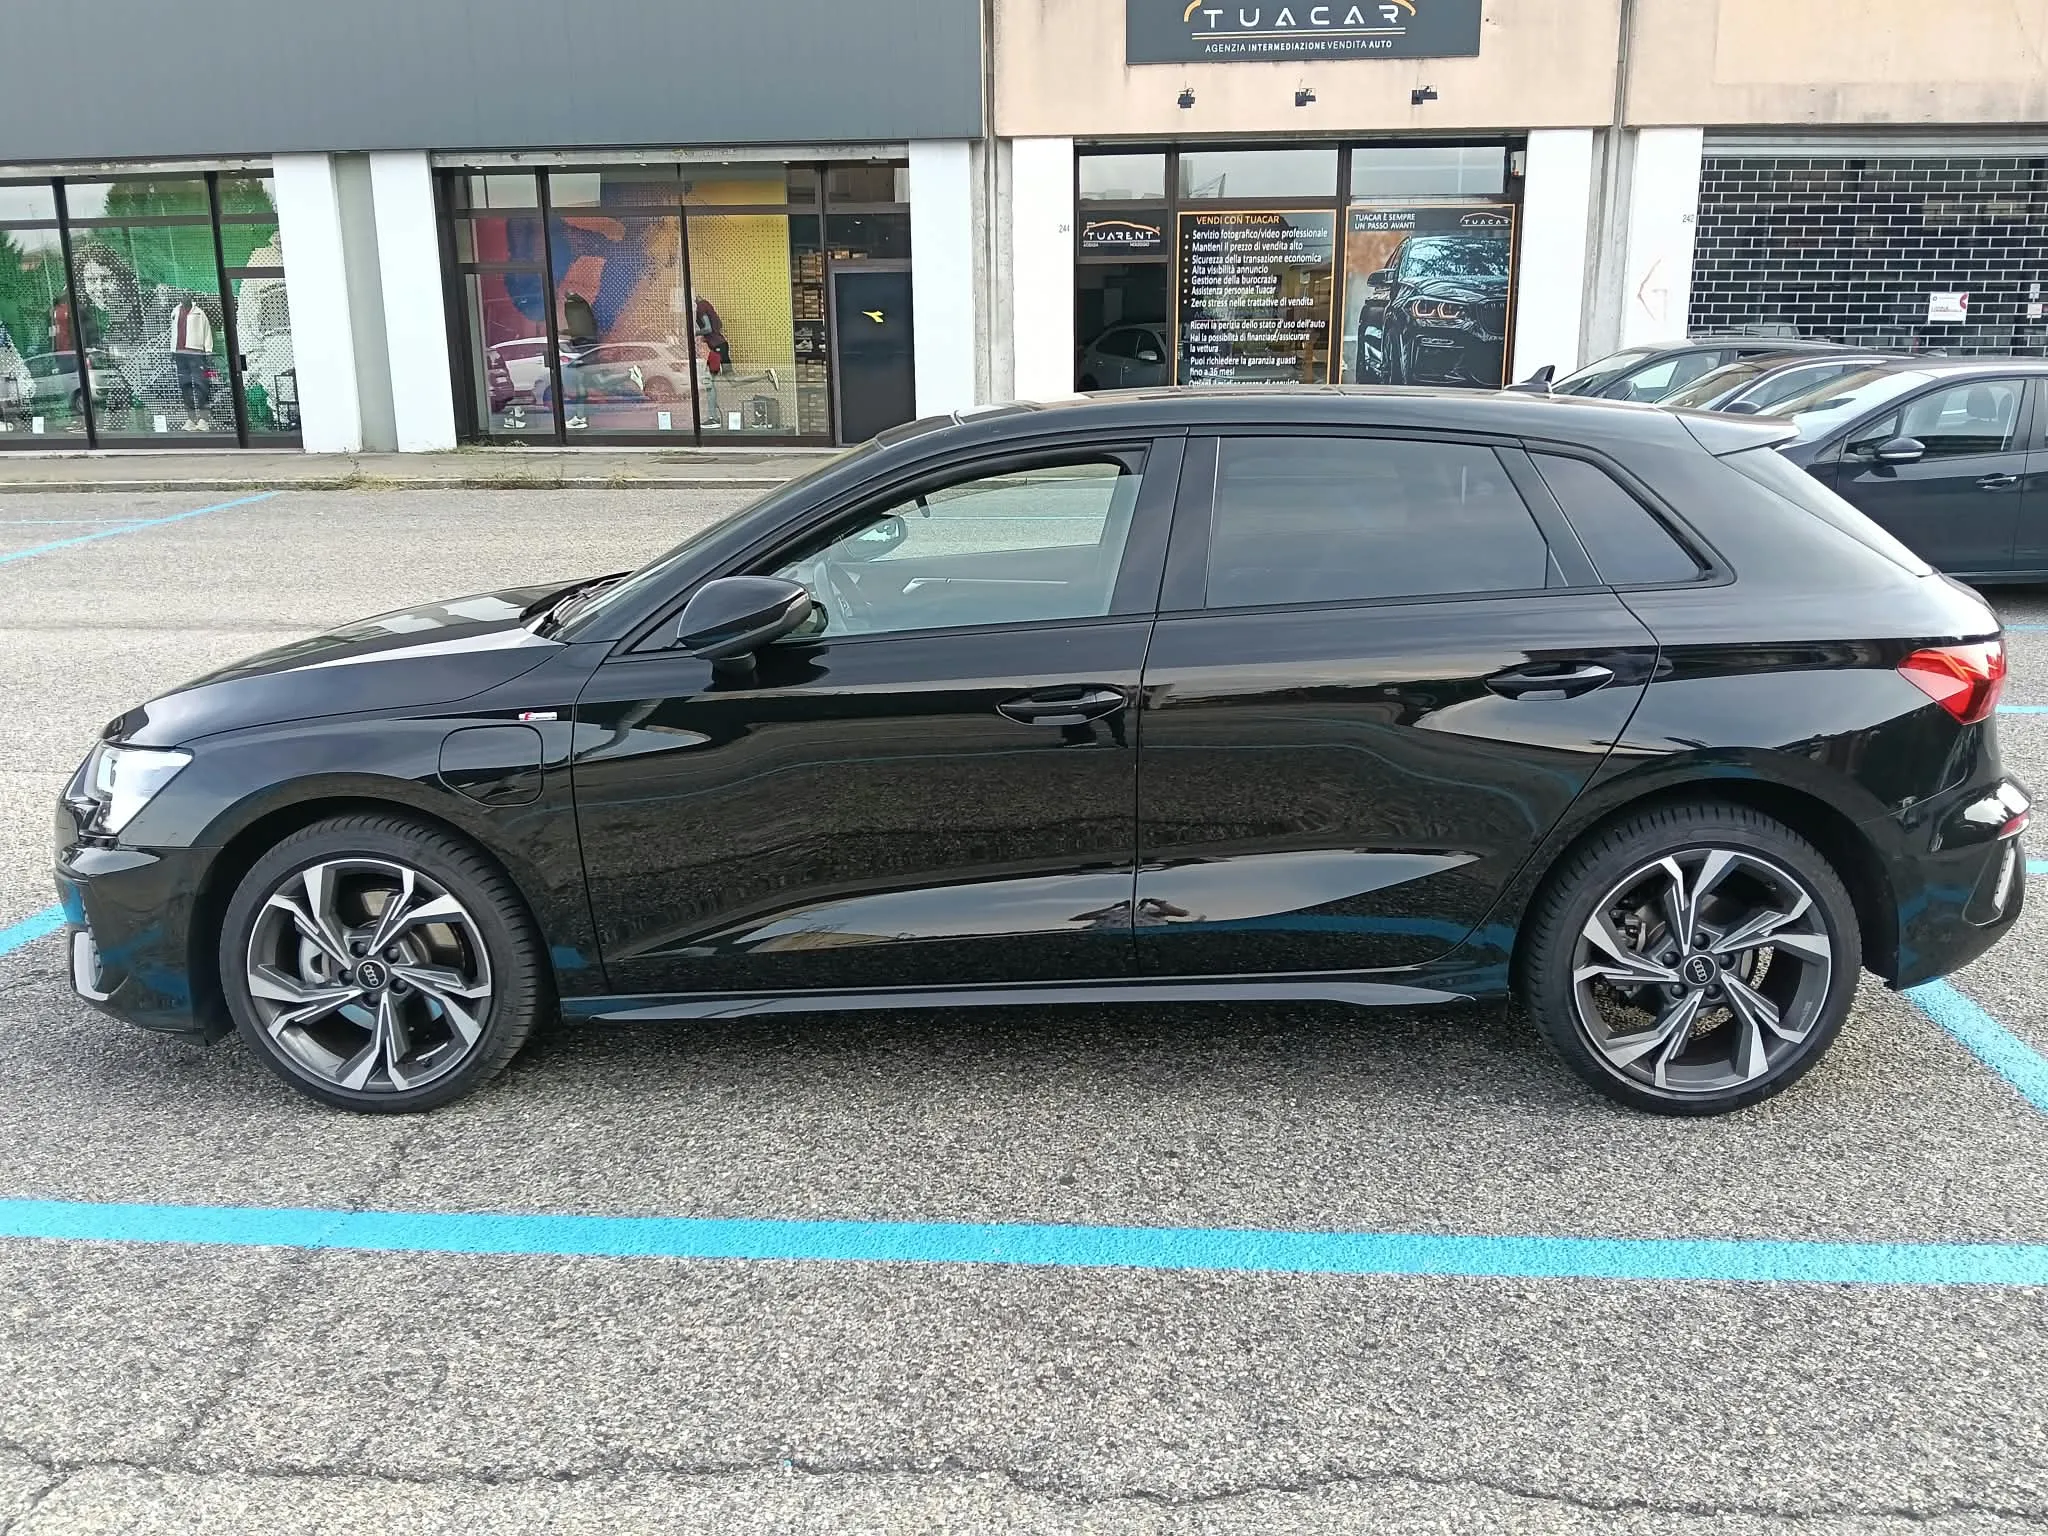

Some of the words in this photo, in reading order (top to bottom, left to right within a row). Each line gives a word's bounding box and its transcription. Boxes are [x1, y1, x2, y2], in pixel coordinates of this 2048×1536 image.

[1203, 5, 1400, 29] TUACAR
[1205, 43, 1246, 53] AGENZIA
[1248, 42, 1326, 52] INTERMEDIAZIONE
[1327, 40, 1367, 50] VENDITA
[1368, 40, 1393, 49] AUTO
[1197, 216, 1223, 225] VENDI
[1224, 216, 1243, 225] CON
[1245, 215, 1280, 224] TUACAR
[1355, 213, 1381, 222] TUACAR
[1389, 213, 1416, 221] SEMPRE
[1354, 222, 1366, 230] UN
[1367, 222, 1389, 230] PASSO
[1390, 221, 1416, 230] AVANTI
[1087, 231, 1154, 241] TUARENT
[1192, 229, 1220, 240] Servizio
[1281, 227, 1328, 240] professionale
[1192, 242, 1223, 251] Mantieni
[1230, 243, 1253, 254] prezzo
[1253, 241, 1261, 251] di
[1262, 240, 1288, 251] vendita
[1289, 240, 1303, 250] alto
[1192, 254, 1224, 264] Sicurezza
[1224, 253, 1241, 264] della
[1242, 254, 1283, 264] transazione
[1284, 252, 1322, 263] economica
[1236, 264, 1269, 274] annuncio
[1191, 275, 1222, 285] Gestione
[1223, 274, 1240, 285] della
[1241, 273, 1277, 284] burocrazia
[1190, 298, 1207, 308] Zero
[1207, 298, 1228, 307] stress
[1229, 297, 1246, 307] nelle
[1280, 296, 1287, 306] di
[1288, 296, 1314, 306] vendita
[1190, 320, 1210, 330] Ricevi
[1218, 320, 1241, 331] perizia
[1241, 319, 1259, 329] dello
[1259, 320, 1276, 329] stato
[1190, 355, 1206, 366] Puoi
